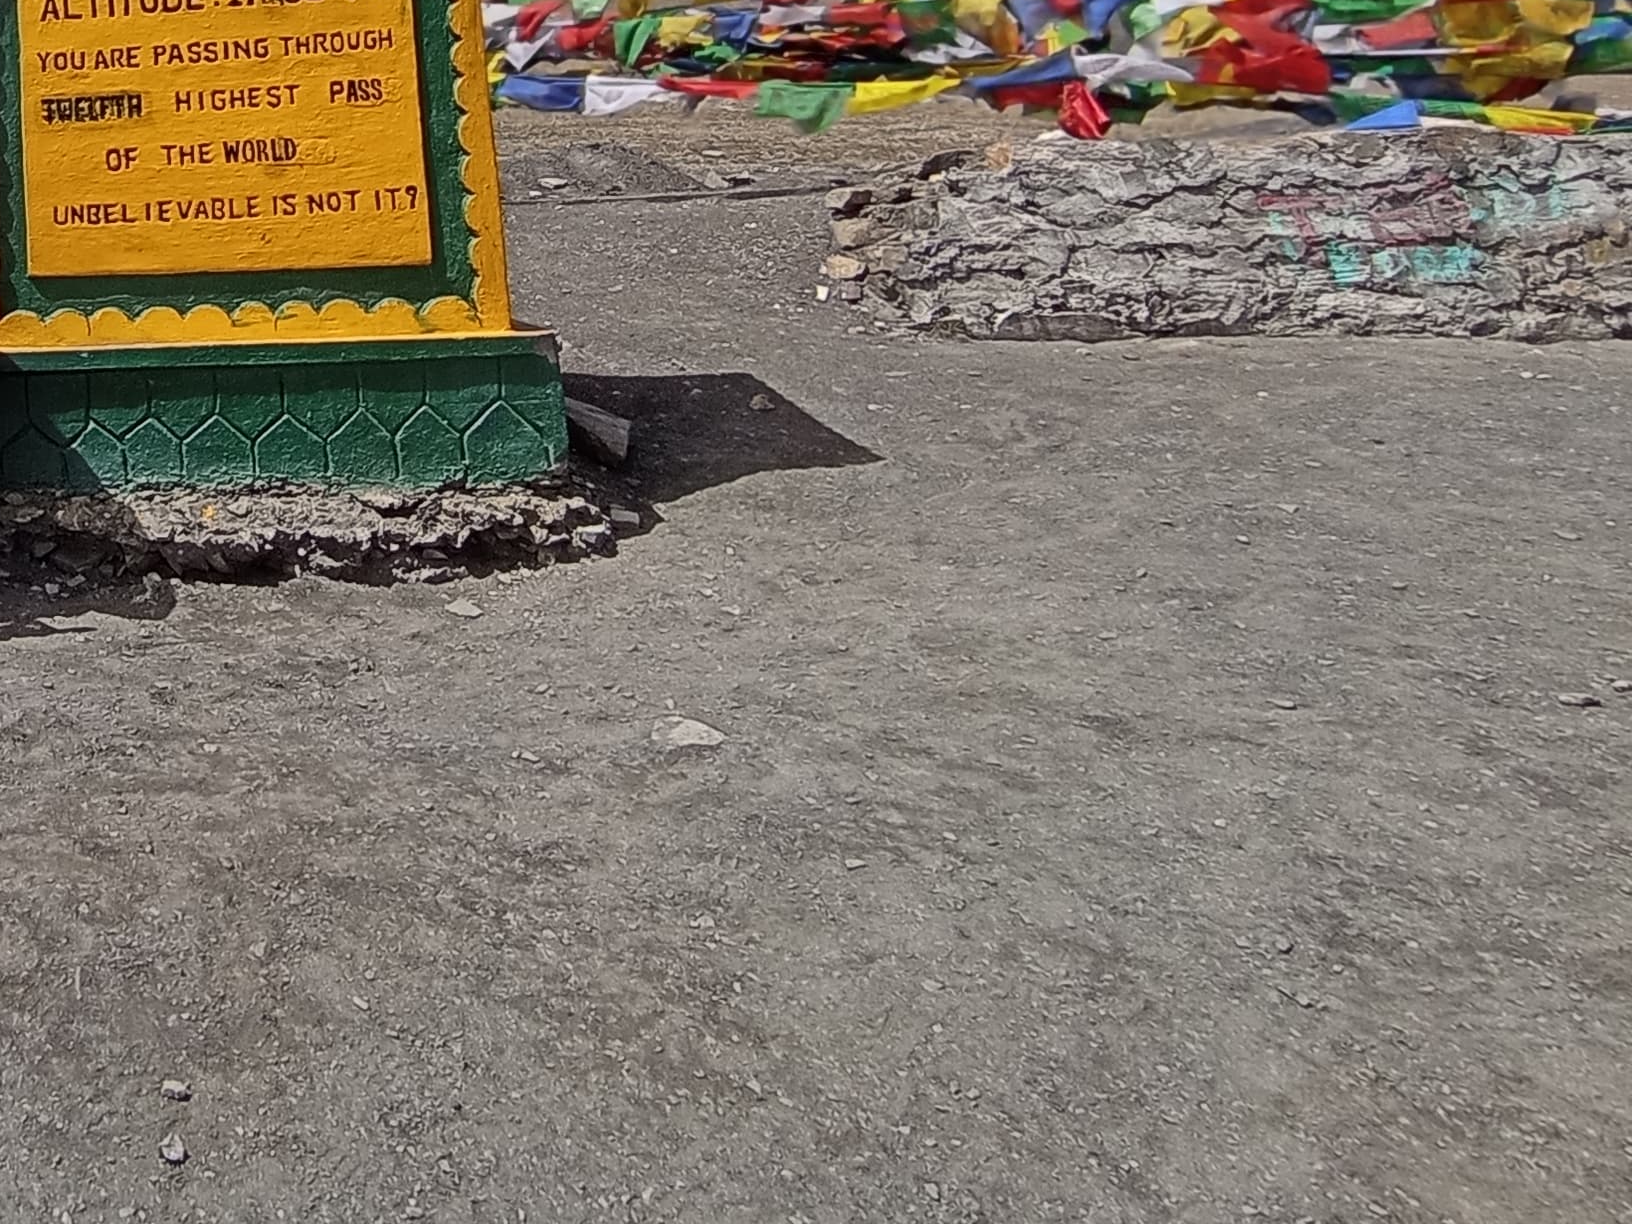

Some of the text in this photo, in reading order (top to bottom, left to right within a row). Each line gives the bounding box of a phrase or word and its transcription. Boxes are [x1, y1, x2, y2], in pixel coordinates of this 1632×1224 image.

[36, 27, 394, 73] YOU ARE PASSING THROUGH
[174, 84, 301, 113] HIGHEST
[329, 78, 384, 104] PASS
[105, 137, 298, 172] OF THE WORLD
[53, 195, 261, 226] UNBELIEVABLE
[272, 192, 298, 217] IS
[306, 189, 362, 215] NOT
